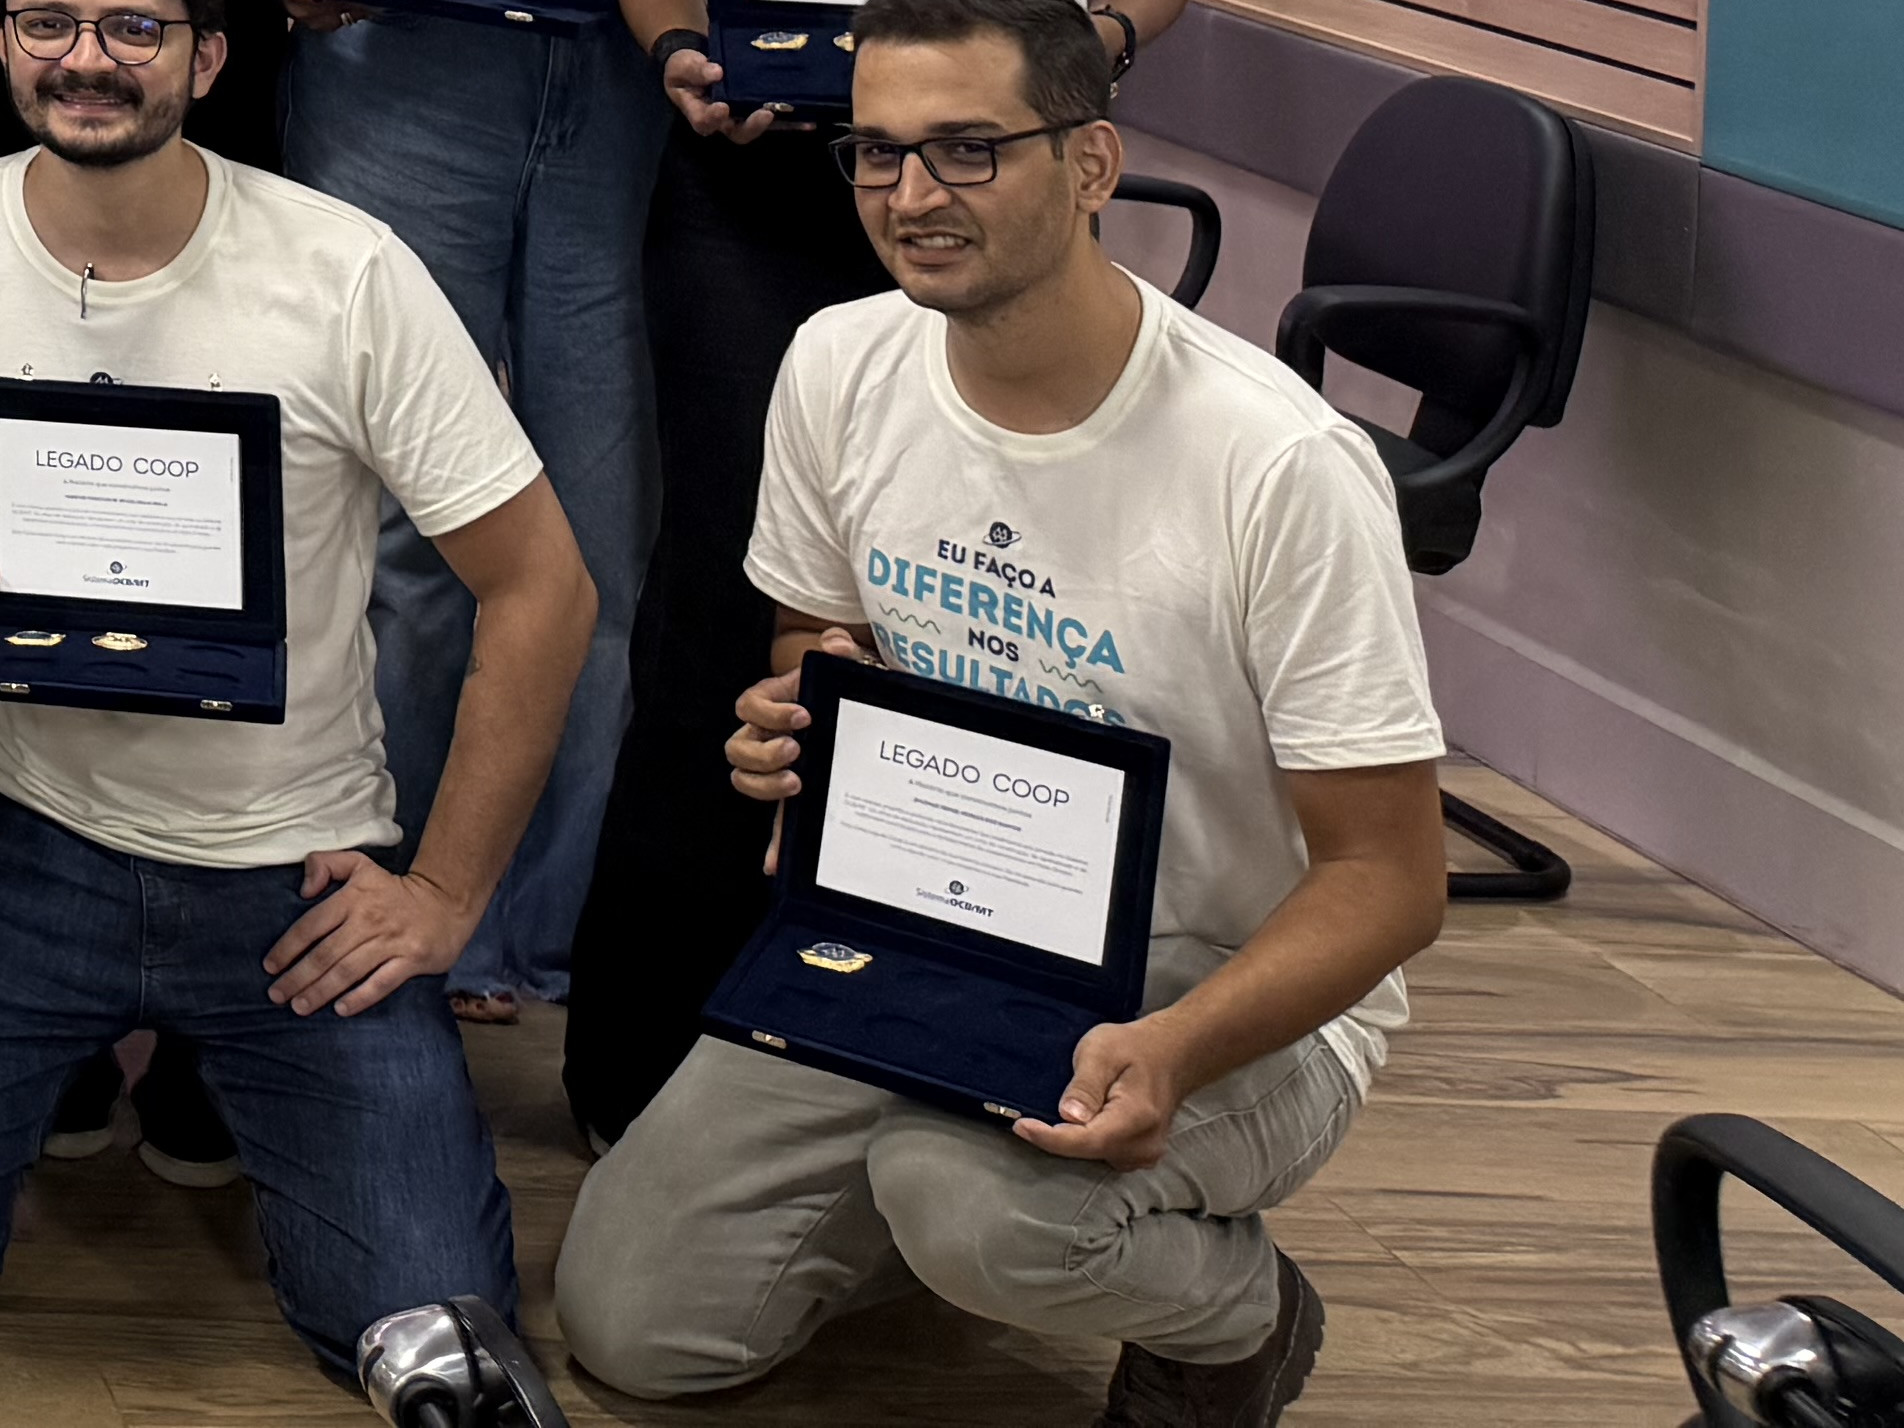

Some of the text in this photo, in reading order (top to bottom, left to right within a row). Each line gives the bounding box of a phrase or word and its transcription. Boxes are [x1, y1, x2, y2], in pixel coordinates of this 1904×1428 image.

[36, 450, 199, 478] LEGADO COOP
[937, 539, 1056, 598] EU FAÇO A
[867, 547, 1125, 674] DIFERENÇA
[968, 627, 1020, 662] NOS
[880, 740, 1070, 807] LEGADO COOP
